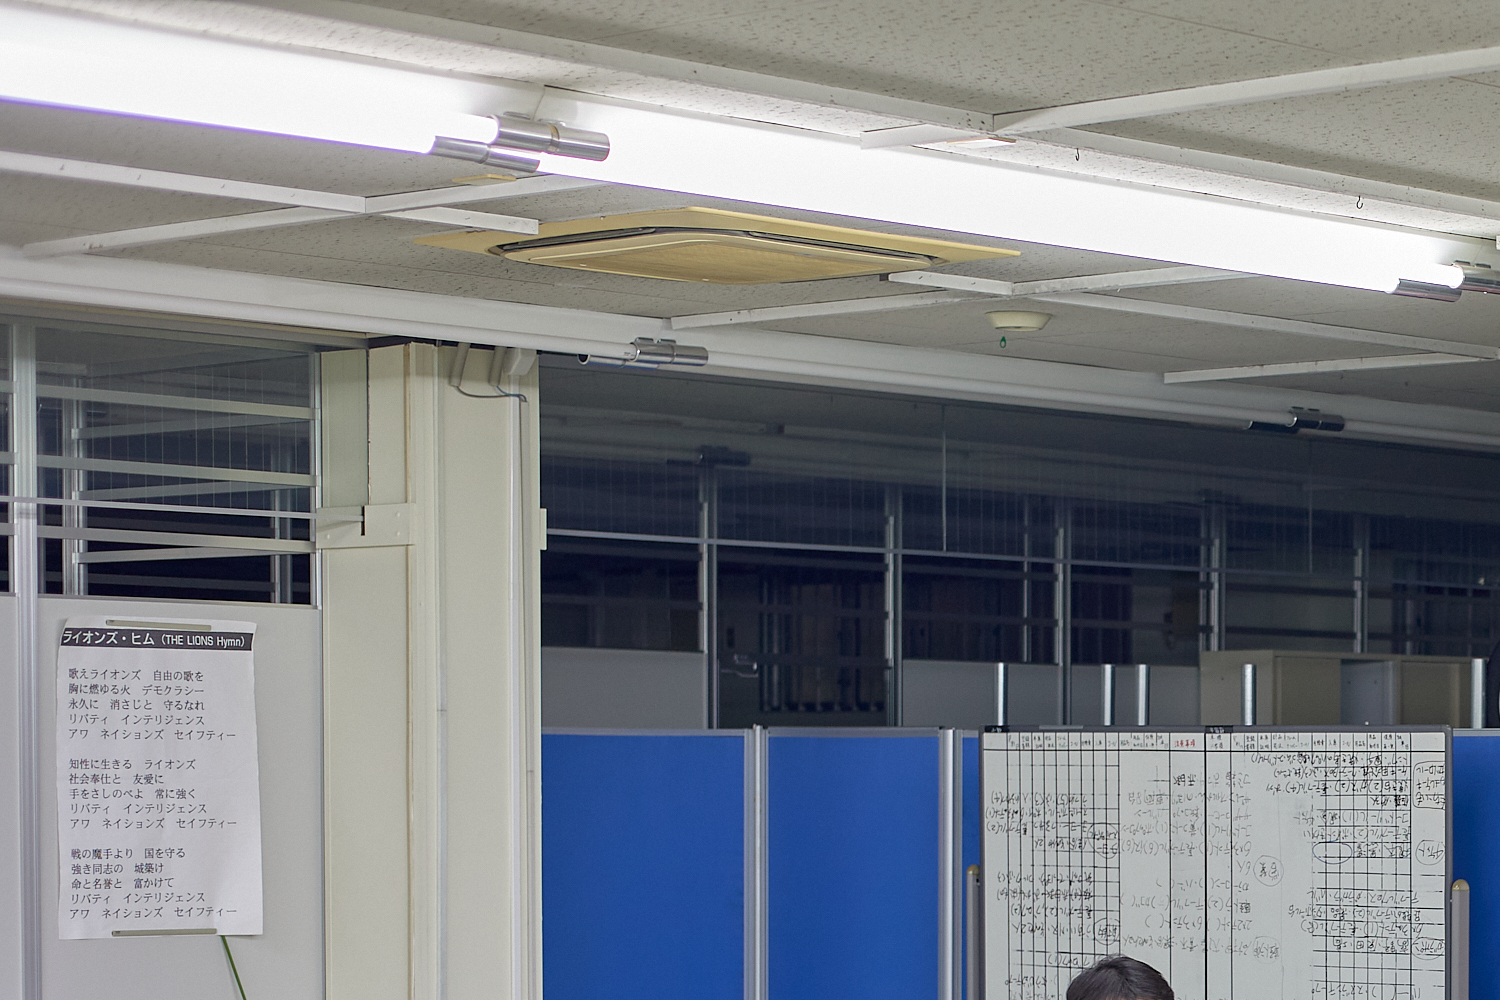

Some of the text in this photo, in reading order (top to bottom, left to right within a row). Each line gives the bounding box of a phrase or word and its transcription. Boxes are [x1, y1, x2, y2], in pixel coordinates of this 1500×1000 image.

[62, 630, 155, 645] ライオンズ・ヒム
[187, 635, 214, 646] LIONS
[68, 668, 204, 682] 歌えライオンズ 自由の歌を
[68, 683, 204, 696] 胸に燃ゆる火 デモクラシー
[68, 698, 205, 711] 永久に 消さじと 守るなれ
[121, 714, 205, 725] インテリジェンス
[69, 728, 236, 740] アワ ネイションズ セイフティー
[69, 758, 196, 770] 知性に生きる ライオンズ
[69, 773, 165, 785] 社会奉仕と 友愛に
[69, 788, 196, 799] 手をさしのべよ 常に強く
[70, 803, 207, 814] リバティ インテリジェンス
[70, 818, 237, 829] アワ ネイションズ セイフティー
[71, 847, 186, 860] 戦の魔手より 国を守る
[71, 862, 164, 875] 強き同志の 城築け
[71, 877, 174, 889] 命と名誉と 富かけて
[71, 892, 205, 904] リバティ インテリジェンス
[69, 906, 237, 919] アワ ネイションズ セイフティー
